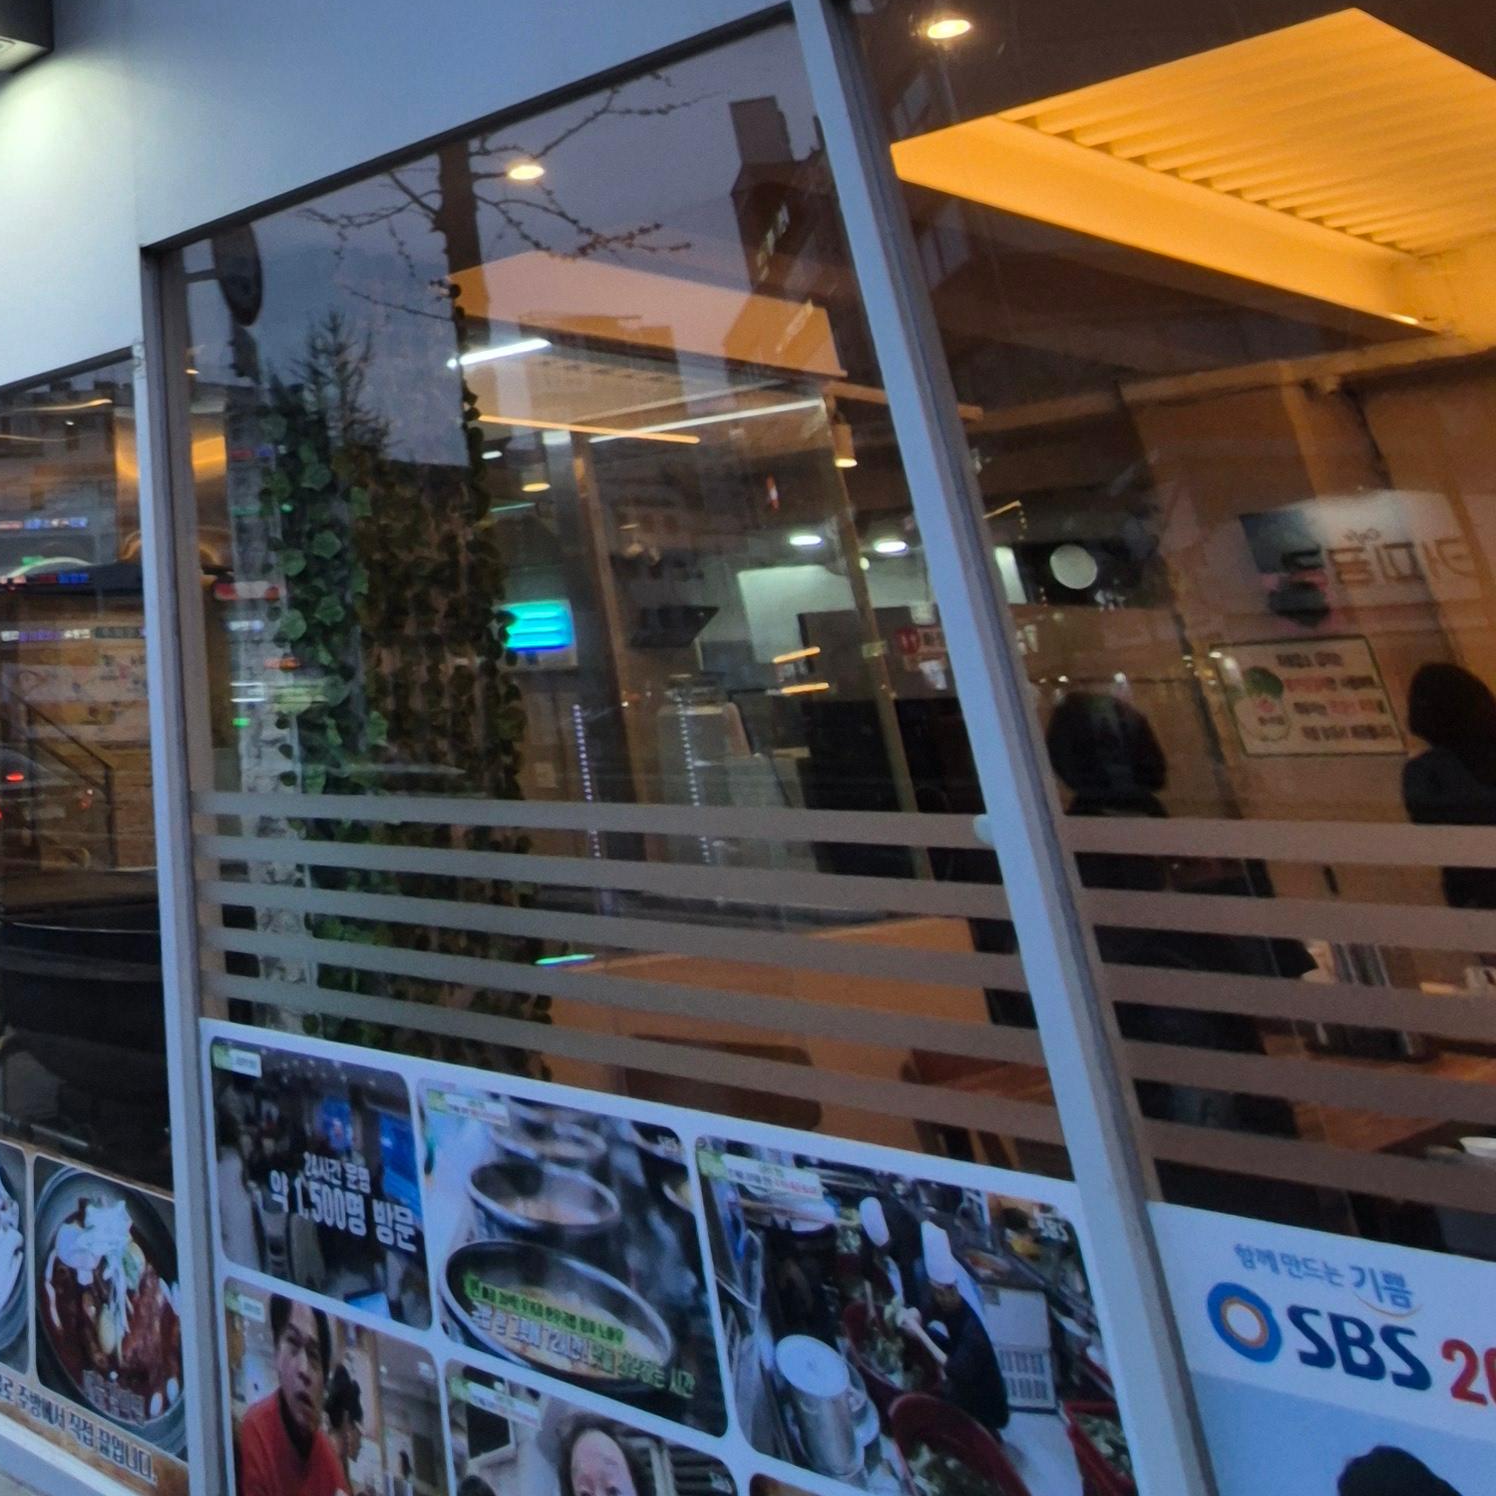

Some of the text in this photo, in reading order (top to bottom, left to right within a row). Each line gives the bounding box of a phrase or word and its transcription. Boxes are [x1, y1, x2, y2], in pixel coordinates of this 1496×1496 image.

[304, 1152, 342, 1184] 24시간
[372, 1199, 417, 1252] 방문
[1349, 1265, 1414, 1310] 기쁨
[1287, 1305, 1432, 1391] SBS
[18, 1384, 65, 1430] 주방에서
[70, 1412, 94, 1448] 직접
